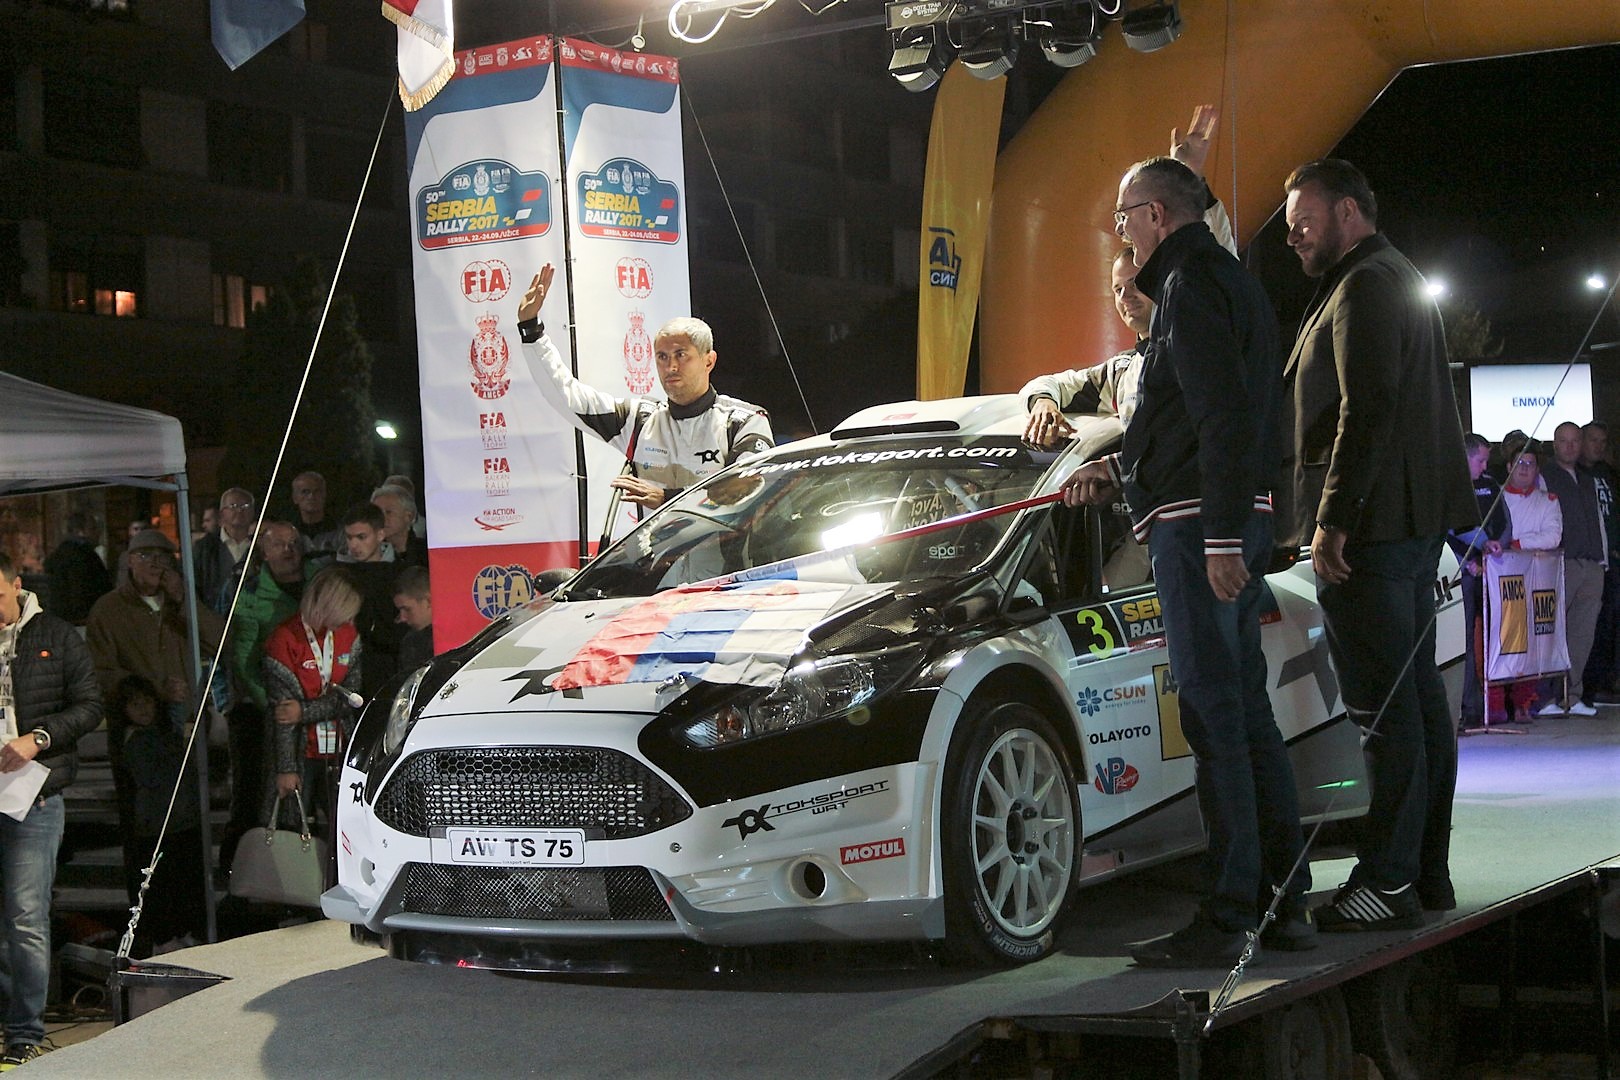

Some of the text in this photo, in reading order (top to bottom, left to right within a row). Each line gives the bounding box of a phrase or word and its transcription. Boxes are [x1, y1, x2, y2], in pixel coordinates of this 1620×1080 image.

[426, 195, 497, 222] SERBIA
[584, 190, 640, 213] SERBIA
[426, 214, 500, 236] RALLY 2017
[585, 209, 642, 227] RALLY 2017
[1512, 396, 1555, 407] ENMON
[482, 434, 507, 443] RALLY
[738, 445, 1018, 479] www.toksport.com
[485, 481, 511, 489] RALLY
[492, 507, 516, 516] ACTION
[1076, 608, 1115, 660] 3
[1103, 683, 1146, 702] CSUN
[1095, 756, 1125, 795] VP
[770, 780, 889, 814] TOKSPORT
[812, 801, 849, 815] WRT
[461, 837, 574, 858] AW TS 75
[844, 839, 904, 863] MOTUL
[993, 933, 1039, 957] MICHELIN
